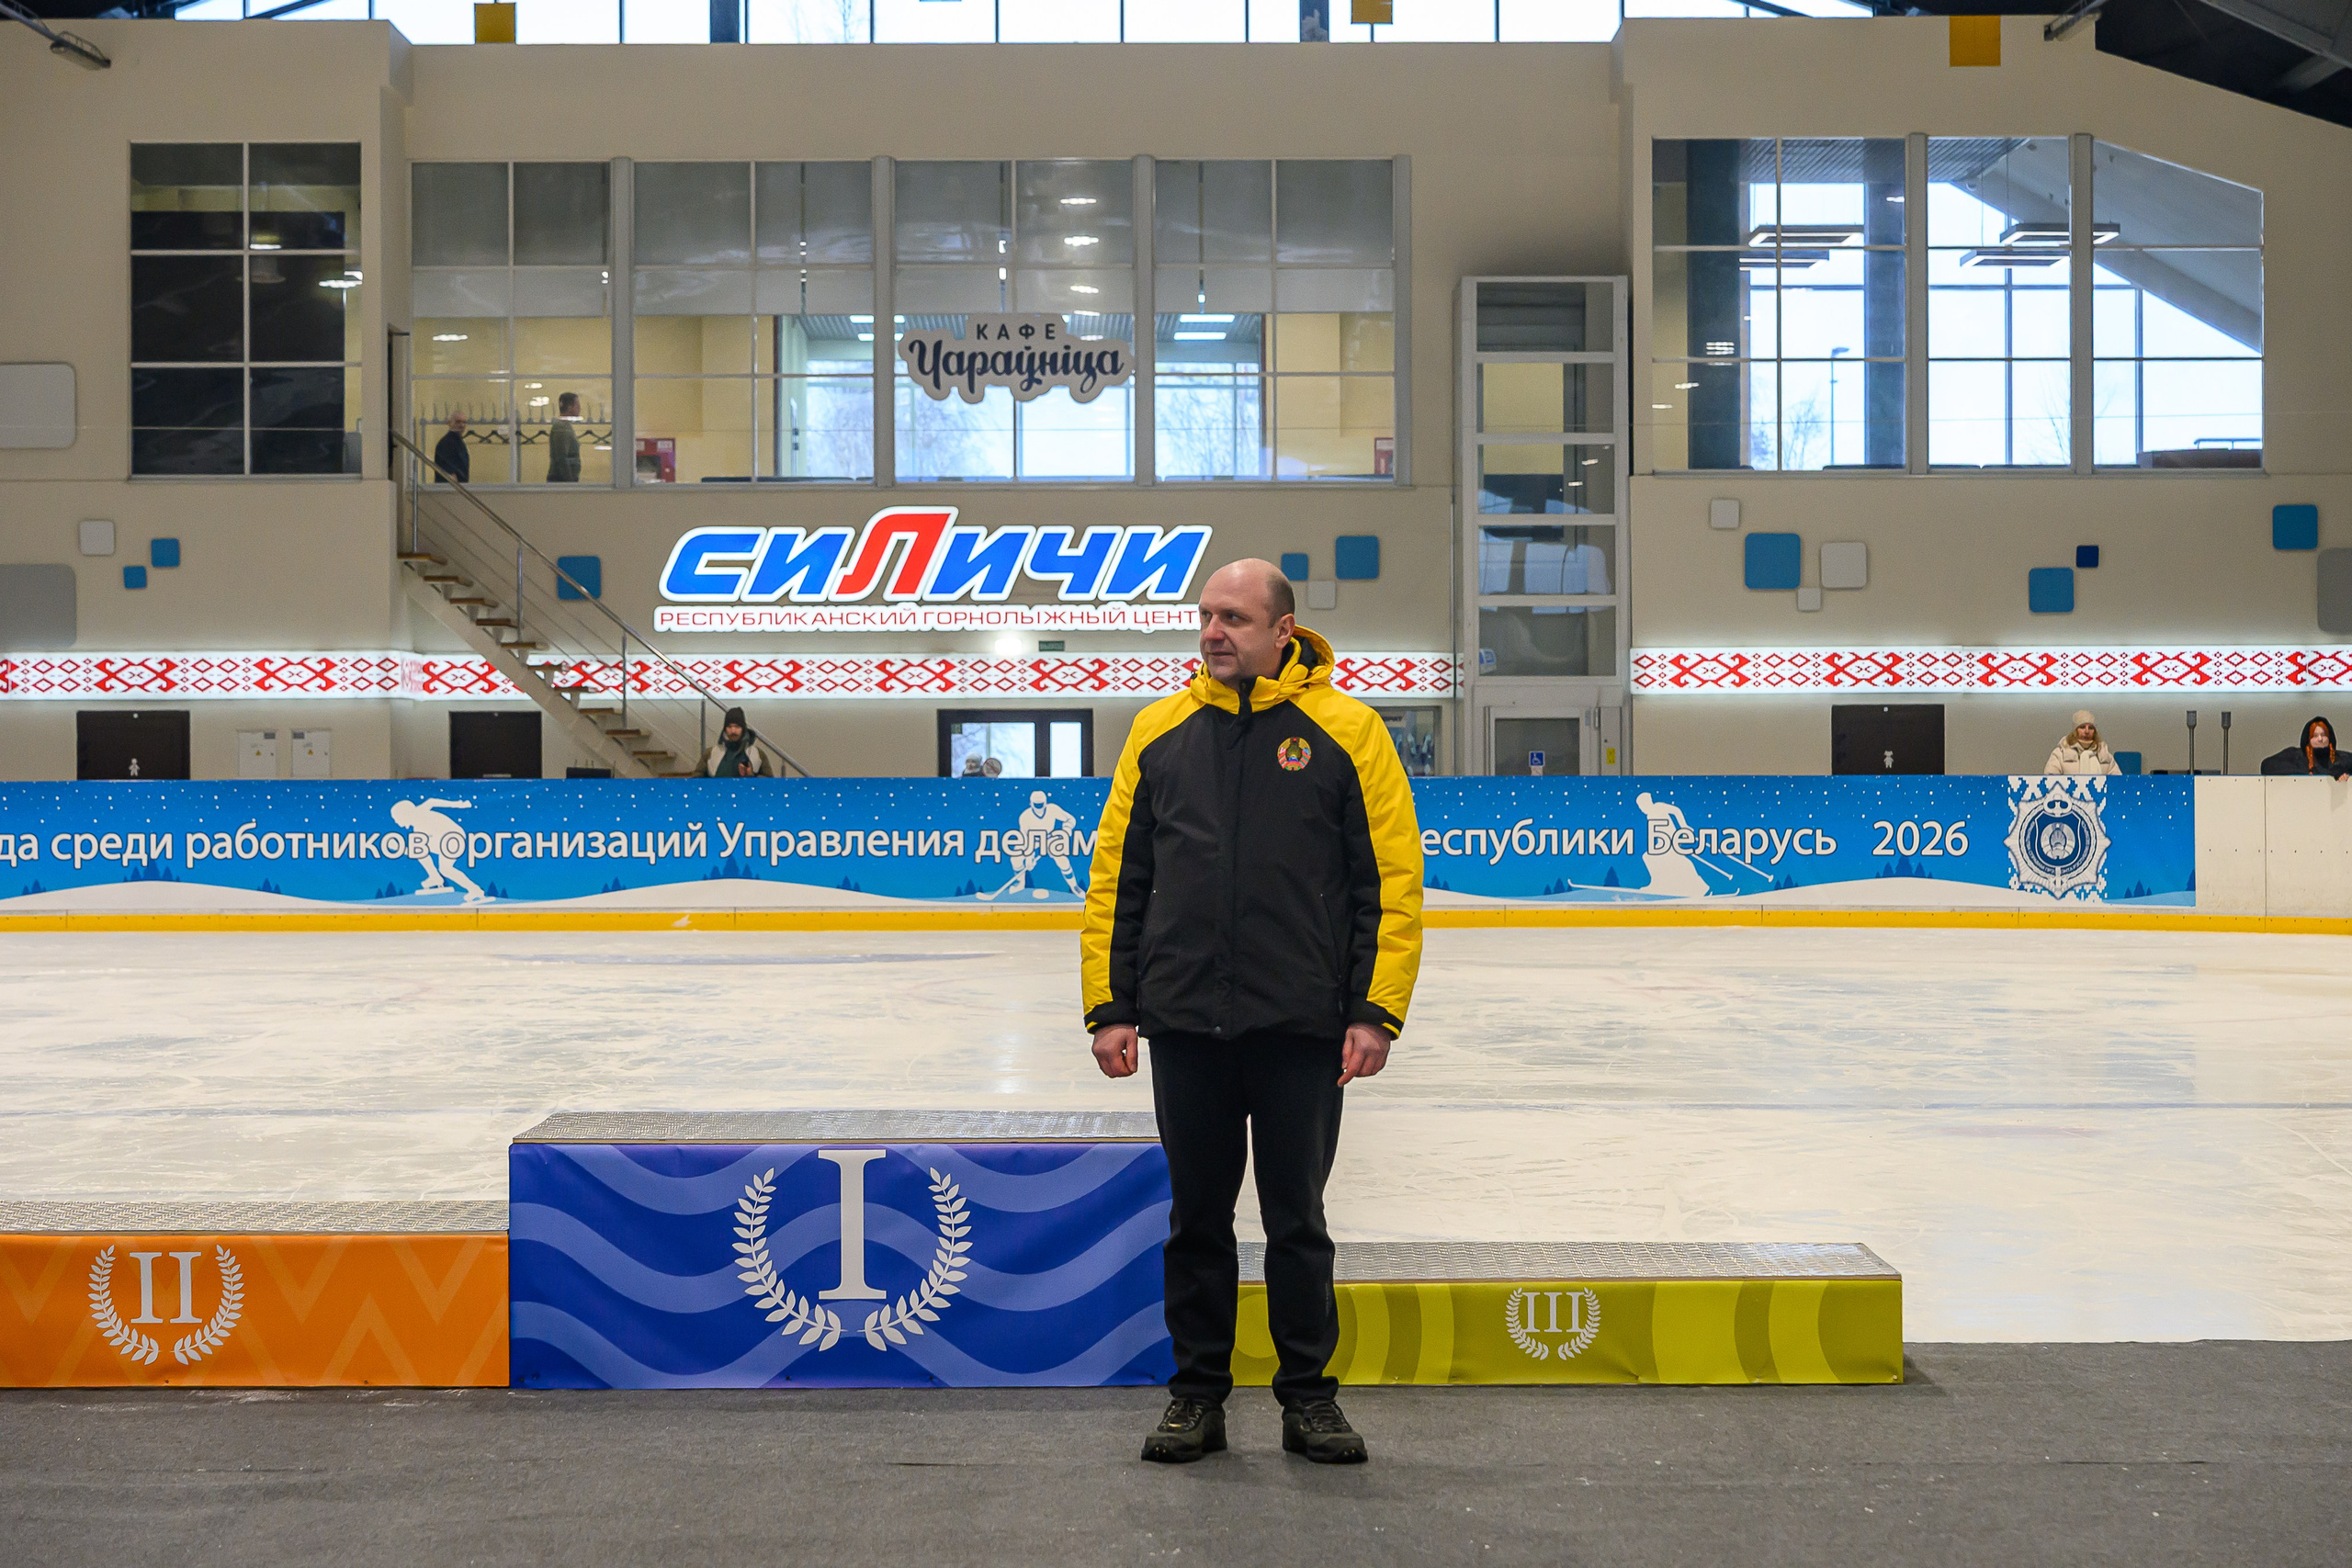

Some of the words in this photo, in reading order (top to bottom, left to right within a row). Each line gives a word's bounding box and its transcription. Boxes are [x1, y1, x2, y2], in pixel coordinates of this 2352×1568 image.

[976, 322, 1057, 341] КАФЕ
[908, 339, 1125, 395] Чараўніца
[660, 606, 917, 626] РЕСПУБЛИКАНСКИЙ
[923, 606, 1125, 626] ГОРНОЛЫЖНЫЙ
[1134, 610, 1201, 627] ЦЕНТ
[51, 832, 174, 870] среди
[186, 821, 430, 869] работников
[439, 822, 707, 868] организаций
[718, 822, 964, 867] Управления
[974, 829, 1099, 863] делам
[1420, 818, 1634, 865] еспублики
[1645, 818, 1838, 865] Беларусь
[1871, 820, 1969, 856] 2026
[818, 1149, 888, 1300] I
[129, 1250, 203, 1325] II
[1521, 1292, 1586, 1333] III
